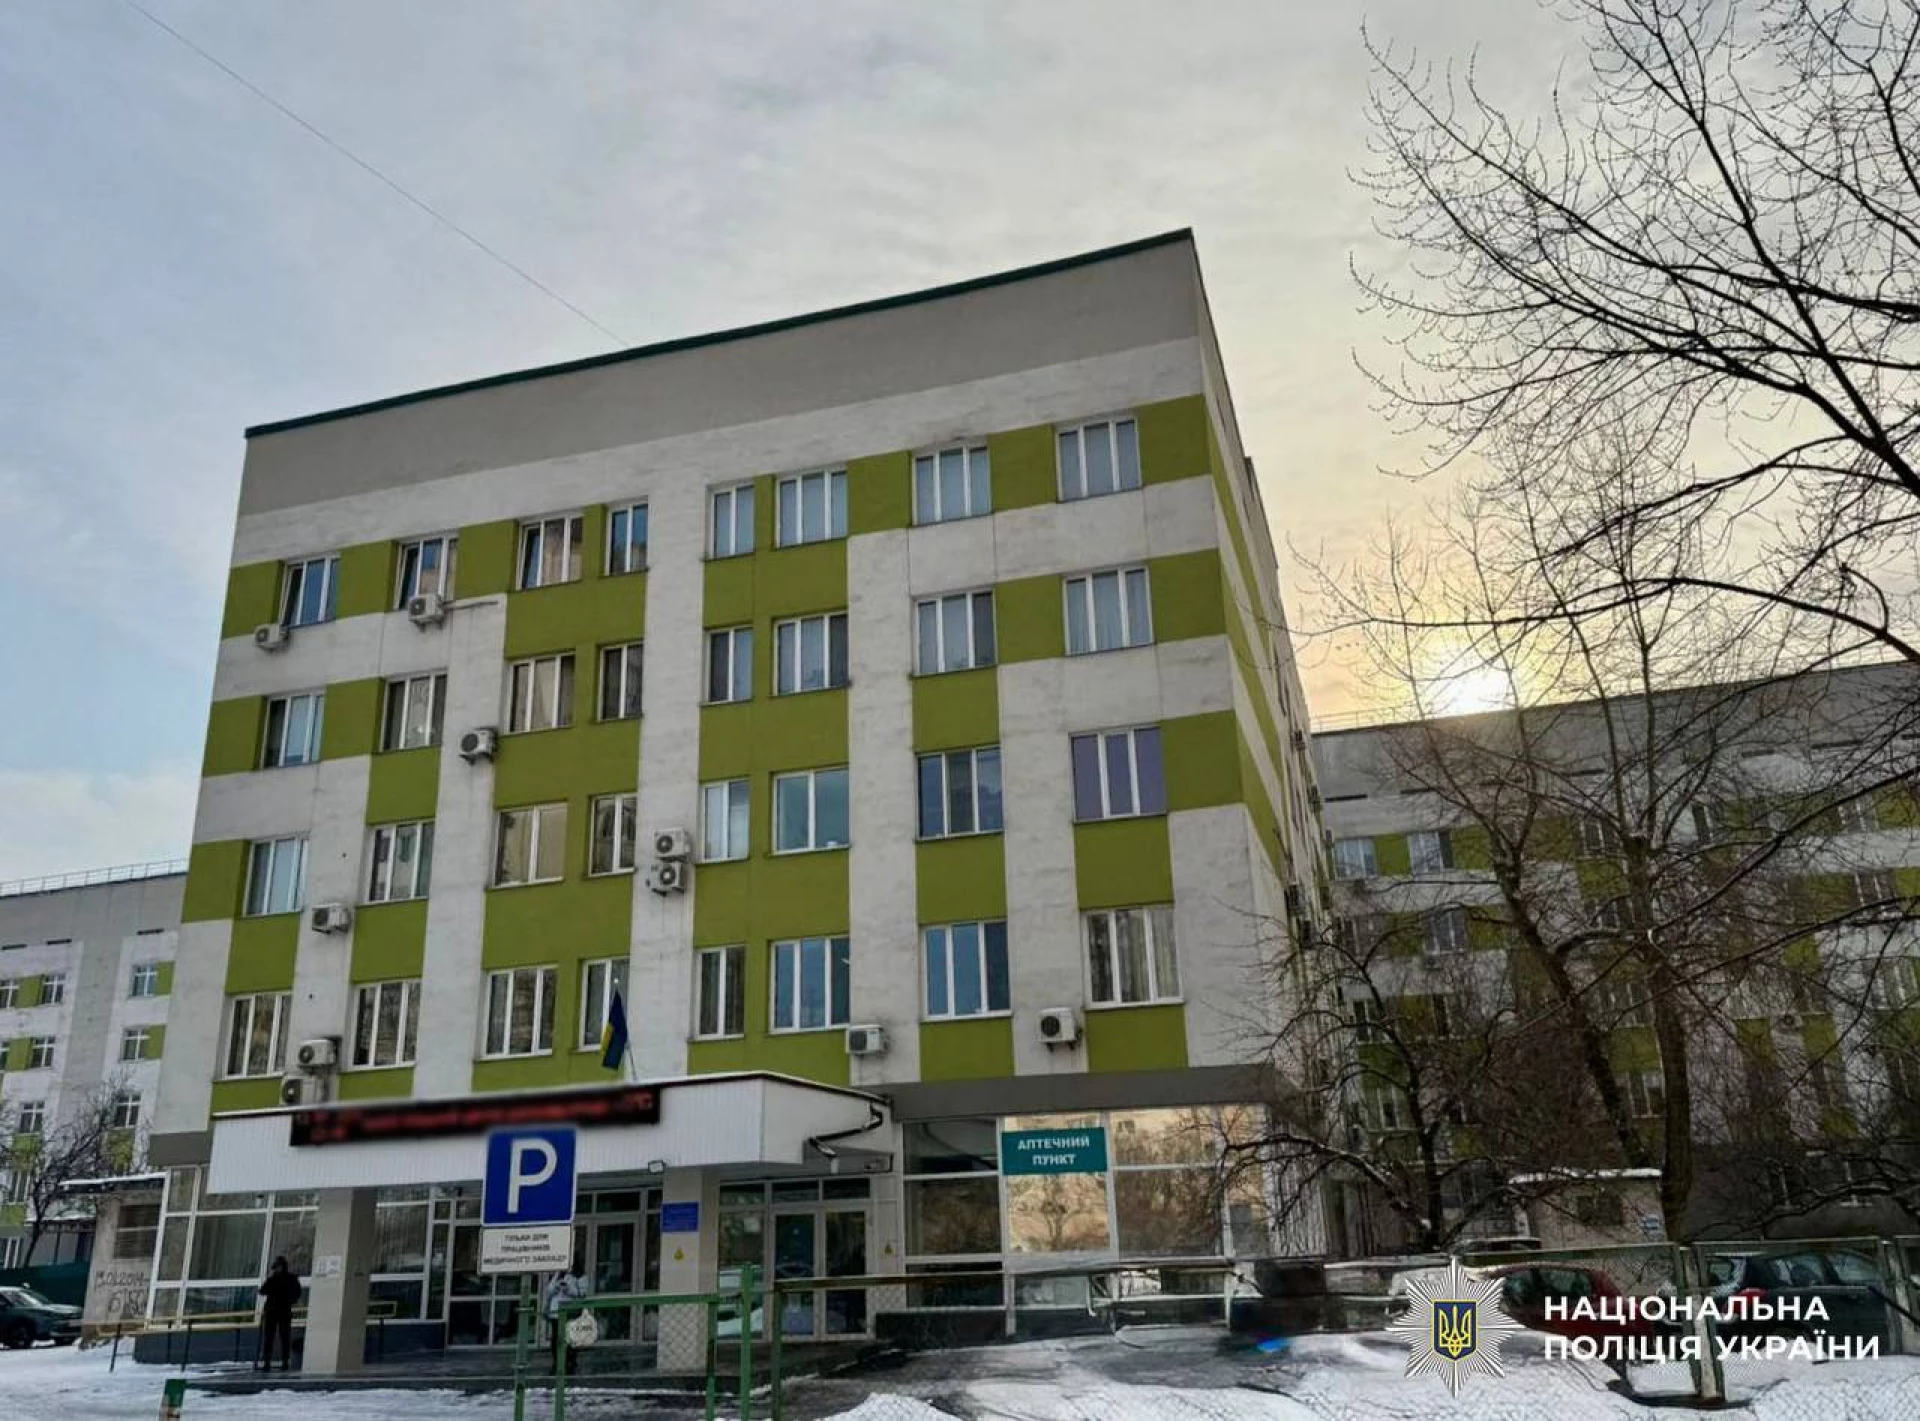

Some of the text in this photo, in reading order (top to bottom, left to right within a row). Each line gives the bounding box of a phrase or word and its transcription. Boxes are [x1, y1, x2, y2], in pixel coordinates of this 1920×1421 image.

[1017, 1136, 1090, 1150] АПТЕЧНИЙ
[1032, 1153, 1077, 1166] ПУНКТ
[507, 1138, 558, 1214] P
